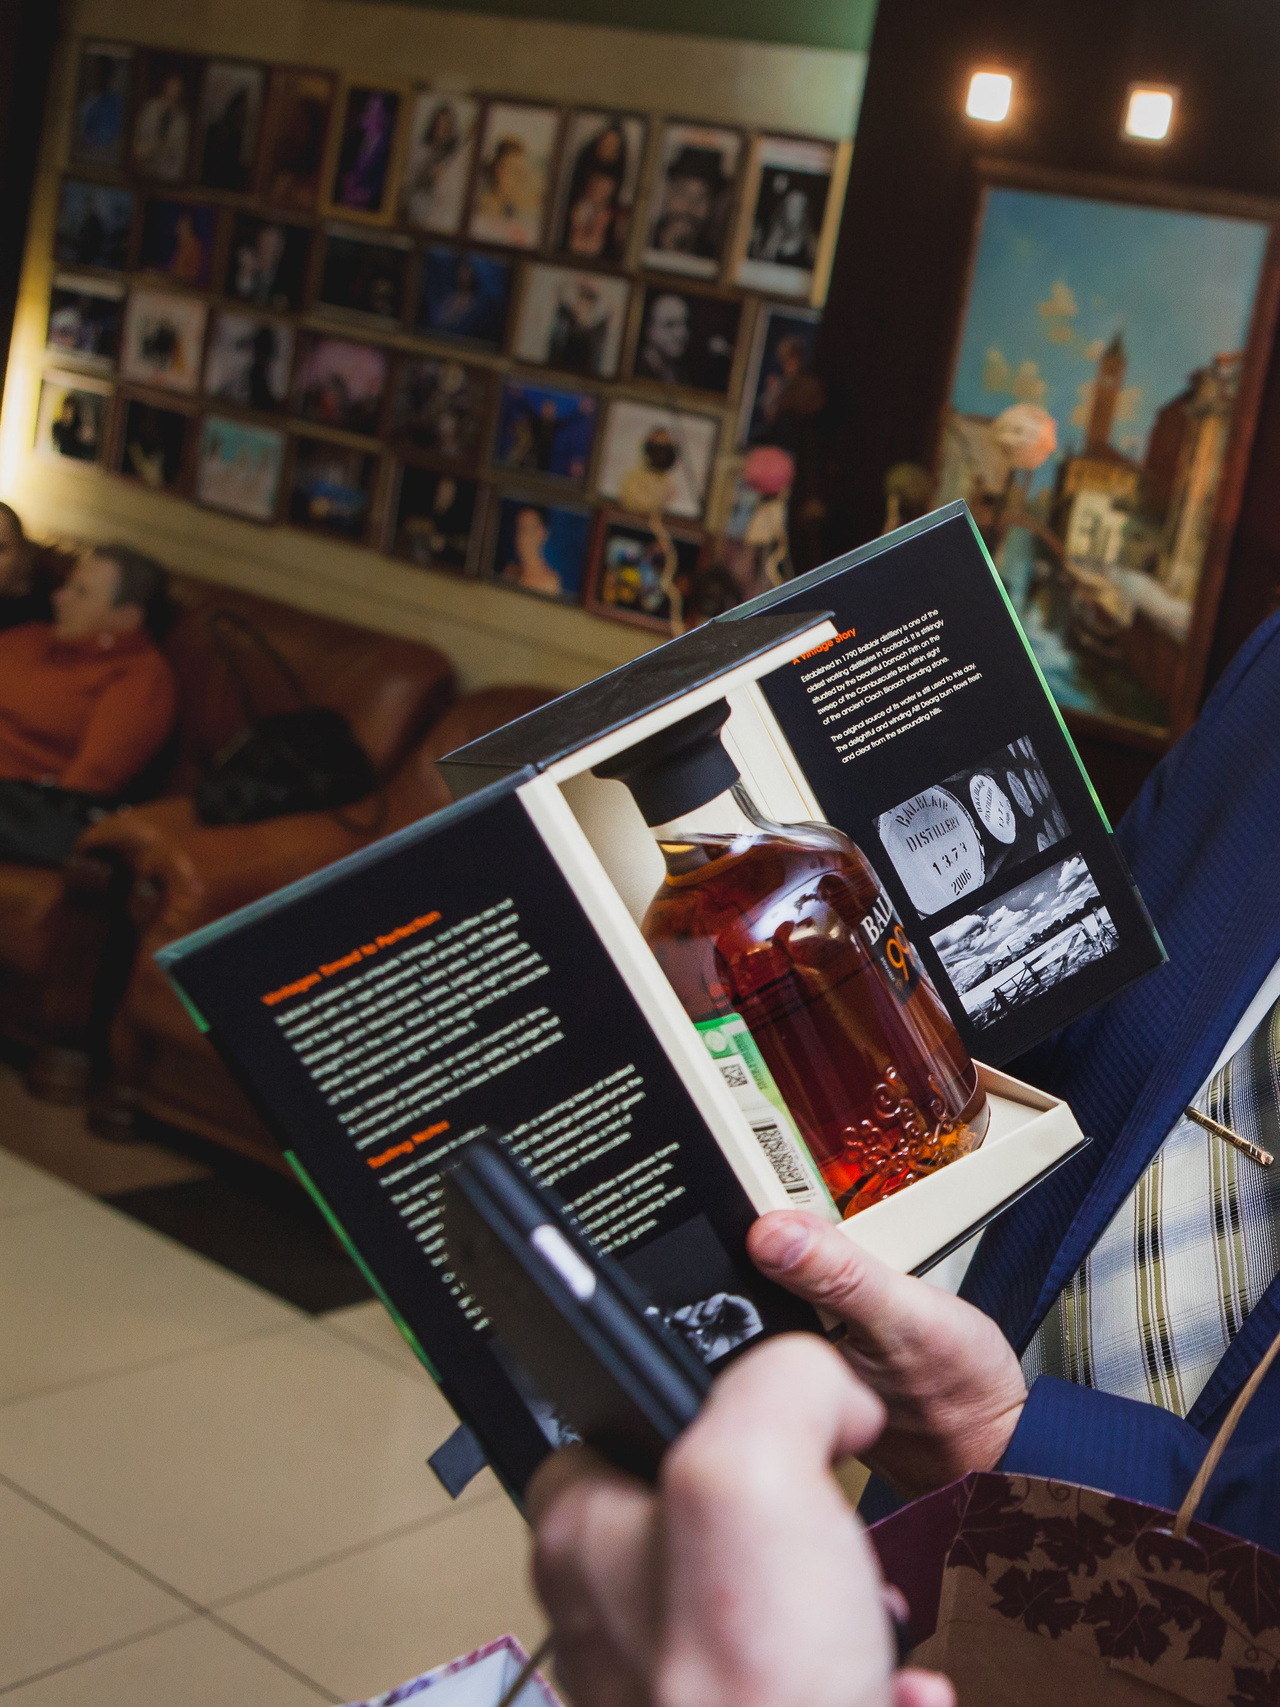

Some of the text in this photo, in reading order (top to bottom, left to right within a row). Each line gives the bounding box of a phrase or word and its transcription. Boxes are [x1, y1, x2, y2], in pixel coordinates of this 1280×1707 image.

[801, 640, 833, 660] Vintage
[834, 628, 855, 643] Story
[801, 661, 835, 682] Established
[842, 650, 858, 661] 1790
[857, 639, 879, 653] Balblair
[880, 627, 902, 642] distillery
[908, 619, 920, 627] one
[928, 610, 938, 618] the
[807, 679, 826, 693] oldest
[826, 669, 849, 683] working
[849, 654, 876, 671] distilleries
[882, 636, 910, 654] Scotland.
[921, 620, 943, 634] strikingly
[812, 687, 836, 704] situated
[845, 678, 856, 686] the
[856, 663, 882, 681] beautiful
[908, 645, 921, 654] Firth
[929, 635, 940, 643] the
[818, 701, 838, 714] sweep
[845, 692, 856, 700] the
[897, 664, 909, 673] Bay
[909, 656, 926, 666] within
[926, 647, 940, 658] sight
[823, 717, 830, 725] of
[830, 713, 841, 721] the
[842, 700, 864, 715] ancient
[865, 691, 884, 703] Clach
[906, 666, 931, 682] standing
[830, 734, 842, 742] The
[843, 721, 865, 736] original
[865, 711, 885, 724] source
[899, 694, 916, 706] water
[922, 686, 931, 694] still
[931, 678, 946, 690] used
[953, 670, 963, 678] this
[836, 744, 848, 752] The
[848, 728, 875, 746] delightful
[876, 721, 888, 732] and
[888, 710, 912, 725] winding
[920, 695, 940, 708] Dearg
[939, 688, 953, 698] burn
[953, 680, 968, 691] flows
[968, 673, 982, 683] fresh
[842, 752, 855, 763] and
[856, 745, 871, 756] clear
[871, 737, 886, 748] from
[886, 732, 896, 740] the
[896, 714, 930, 734] surrounding
[895, 794, 949, 828] BALBLAIR
[905, 815, 961, 853] DISTILLERY
[950, 868, 973, 896] 2006
